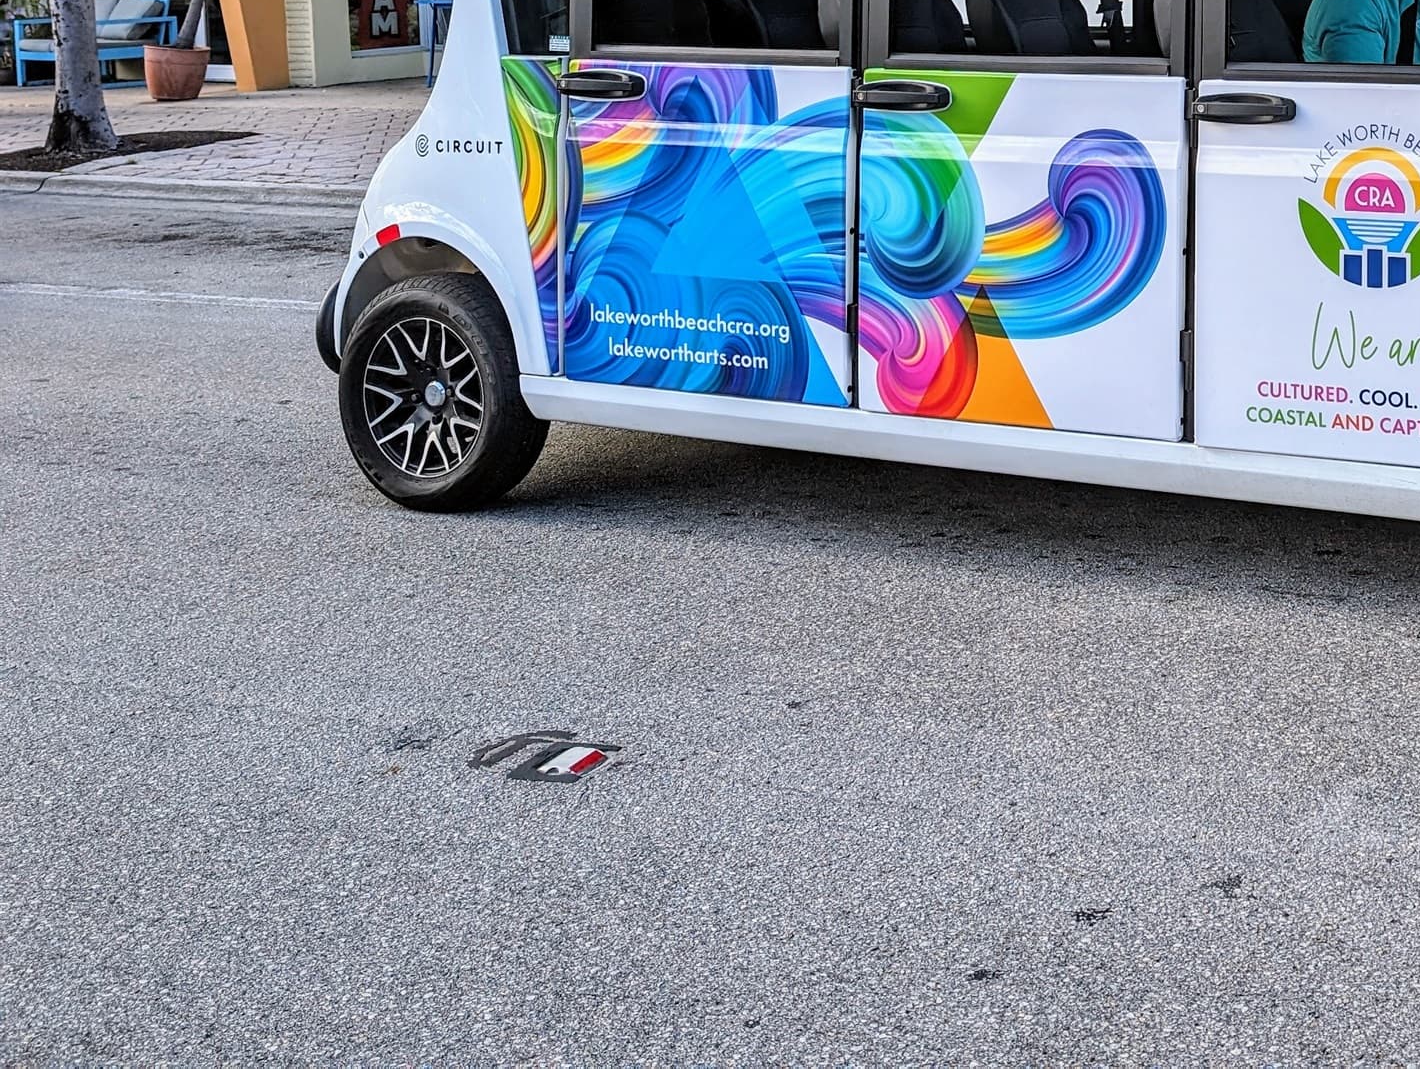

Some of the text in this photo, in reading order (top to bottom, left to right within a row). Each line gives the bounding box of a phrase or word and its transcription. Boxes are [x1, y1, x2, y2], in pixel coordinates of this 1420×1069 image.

[435, 139, 504, 155] CIRCUIT
[1304, 141, 1339, 184] LAKE
[1336, 123, 1401, 147] WORTH
[1354, 185, 1395, 208] CRA
[590, 303, 791, 343] lakeworthbeachcra.org
[1311, 301, 1378, 370] We
[608, 337, 769, 371] lakewortharts.com
[1257, 380, 1353, 404] CULTURED.
[1359, 388, 1418, 410] COOL.
[1246, 406, 1327, 429] COASTAL
[1331, 412, 1374, 431] AND
